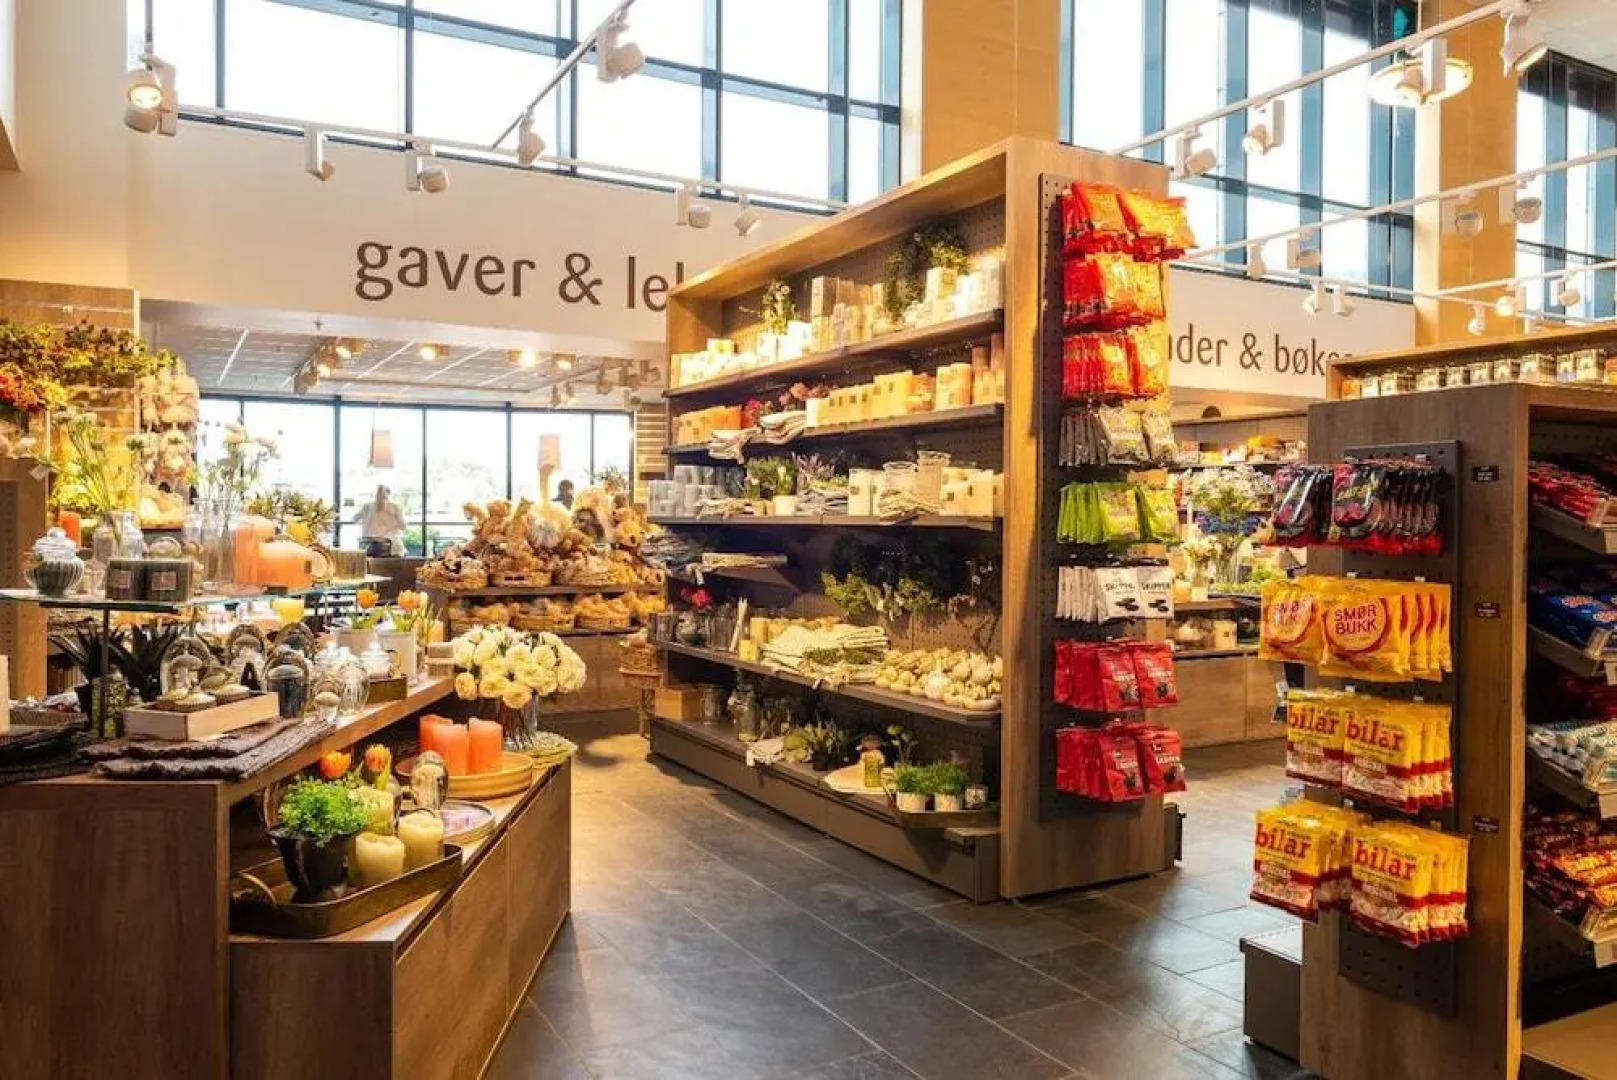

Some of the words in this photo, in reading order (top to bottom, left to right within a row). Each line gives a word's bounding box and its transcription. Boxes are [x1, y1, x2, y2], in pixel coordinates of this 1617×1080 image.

[355, 240, 537, 302] gaver
[558, 251, 603, 306] &
[1168, 323, 1229, 368] der
[1239, 332, 1264, 371] &
[1275, 333, 1353, 377] bøk
[1334, 604, 1377, 622] SMØR
[1335, 618, 1377, 635] BUKK
[1346, 713, 1405, 751] bilar
[1255, 823, 1312, 859] bilar
[1354, 839, 1417, 880] bilar
